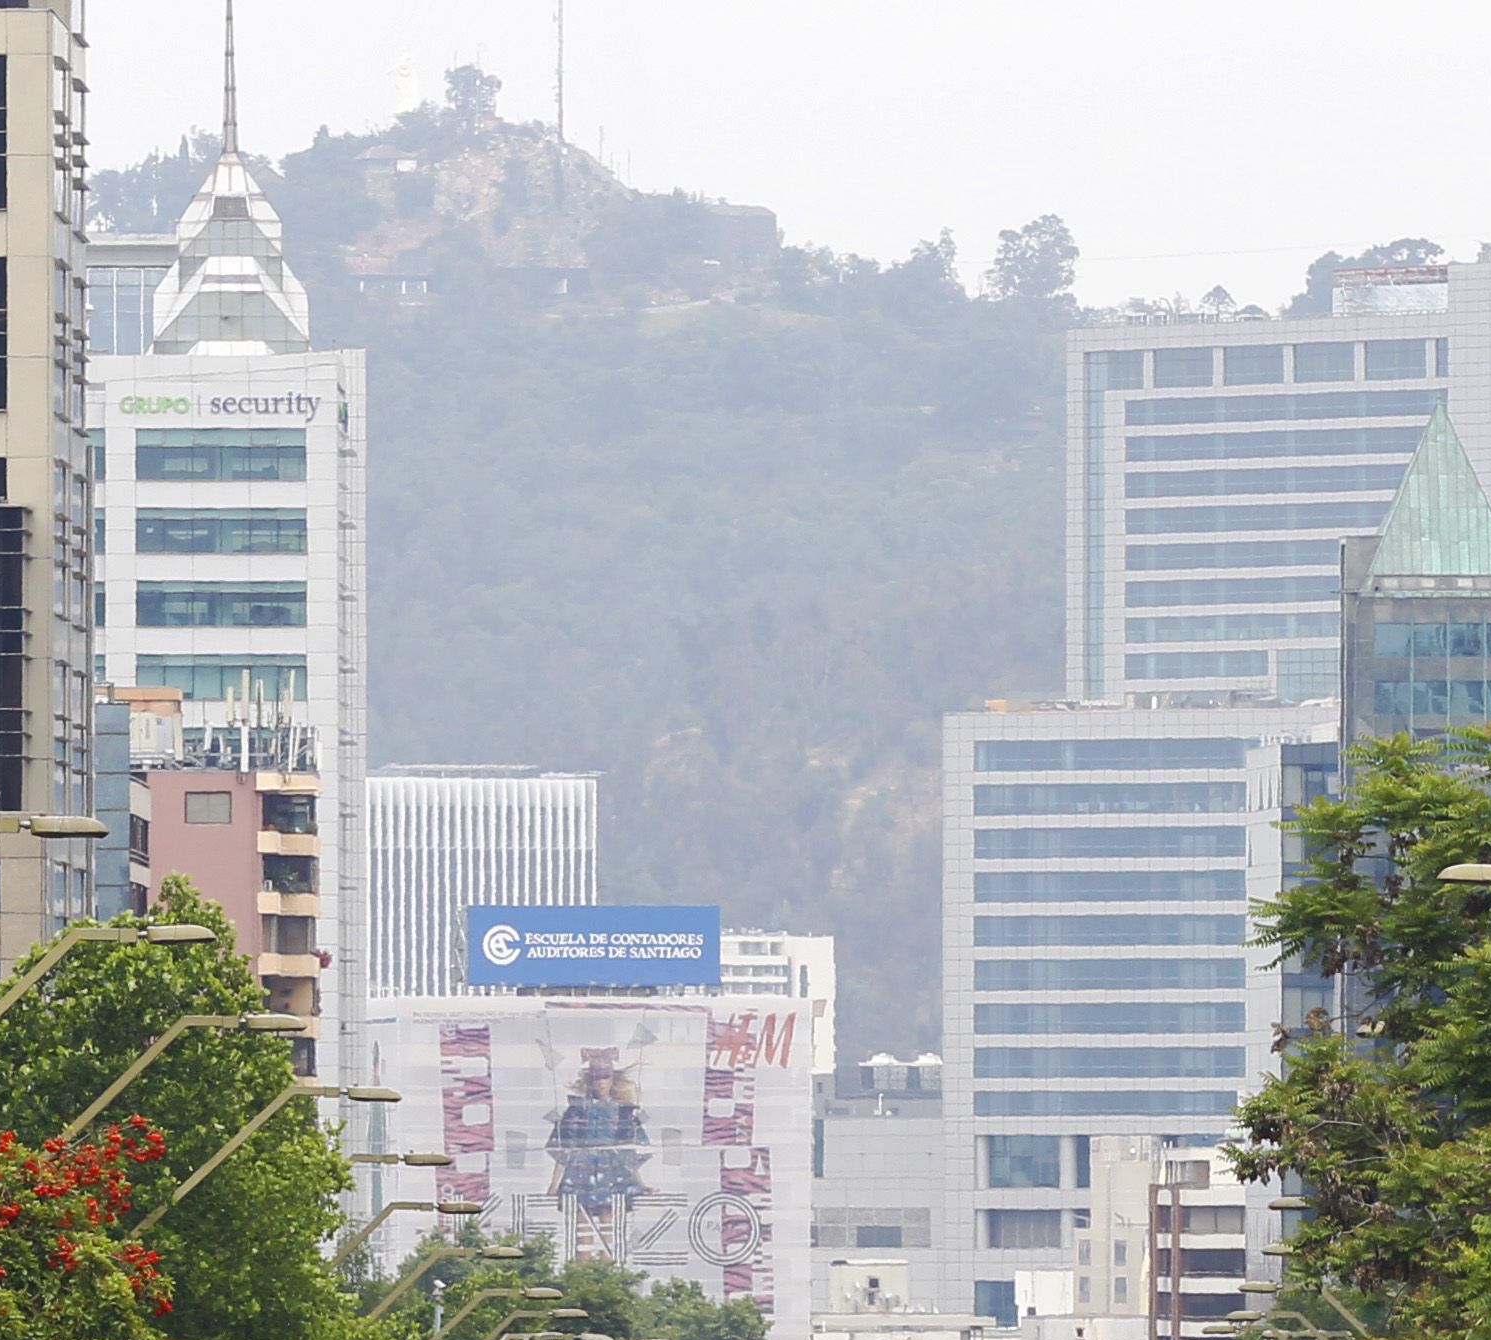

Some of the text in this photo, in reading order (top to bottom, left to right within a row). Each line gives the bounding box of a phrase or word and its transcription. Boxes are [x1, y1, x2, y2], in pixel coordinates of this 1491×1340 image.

[119, 391, 322, 422] GRUPO security
[524, 932, 704, 947] ESCUELA DE CONTADORES
[527, 946, 703, 960] AUDITORES DE SANTIAGO
